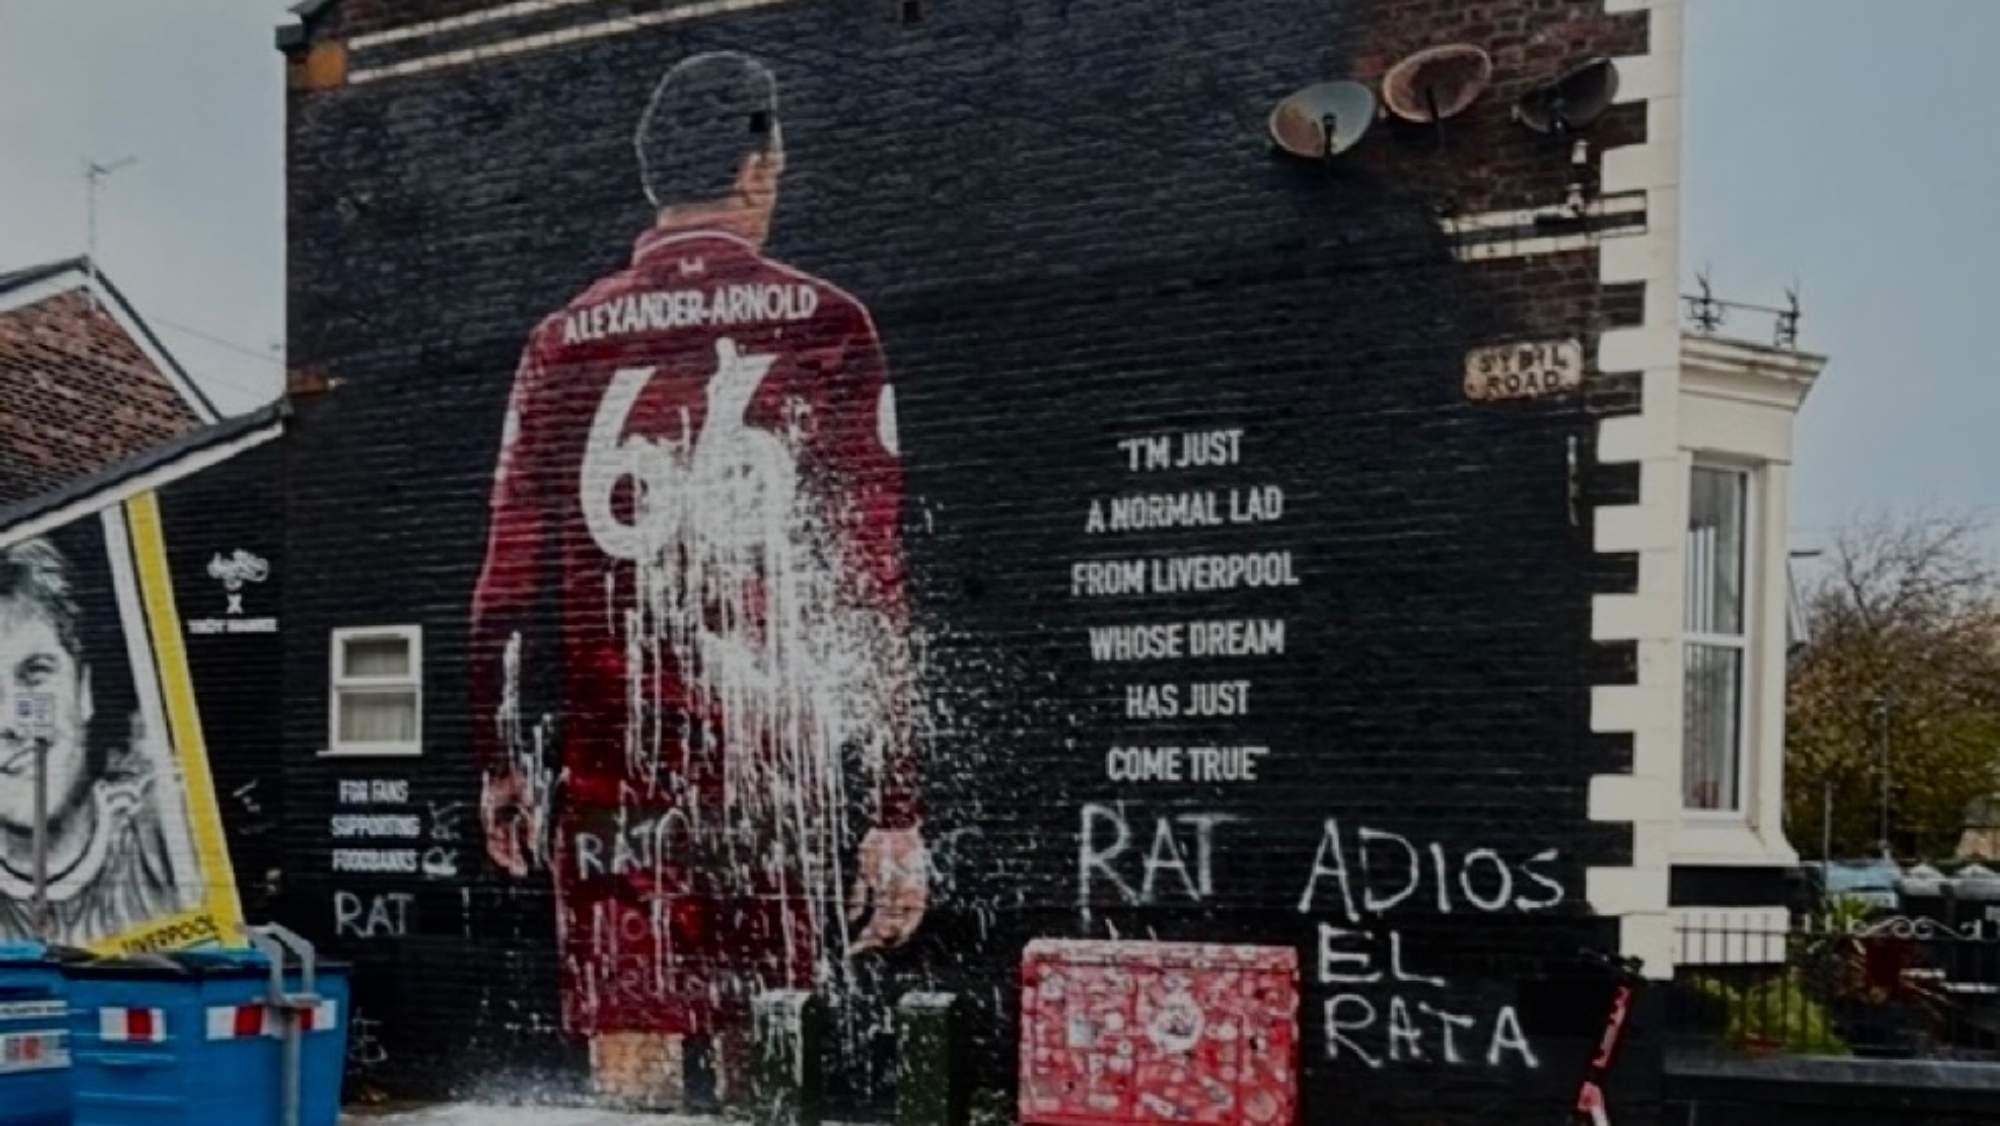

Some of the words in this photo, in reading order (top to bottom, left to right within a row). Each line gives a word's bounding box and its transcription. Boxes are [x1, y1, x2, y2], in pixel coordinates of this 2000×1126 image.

[563, 283, 818, 345] ALEXANDER-ARNOLD
[1176, 429, 1244, 468] JUST
[1085, 499, 1105, 534] A
[1110, 491, 1223, 531] NORMAL
[1230, 485, 1283, 524] LAD
[1070, 559, 1145, 595] FROM
[1151, 550, 1300, 593] LIVERPOOL
[1089, 623, 1184, 661] WHOSE
[1188, 618, 1284, 656] DREAM
[1125, 684, 1179, 718] HAS
[1183, 680, 1251, 715] JUST
[1105, 746, 1181, 781] COME
[1078, 803, 1248, 928] RAT
[1298, 818, 1565, 921] ADIOS
[334, 892, 415, 938] RAT
[1317, 922, 1446, 986] EL
[1323, 993, 1540, 1068] RATA
